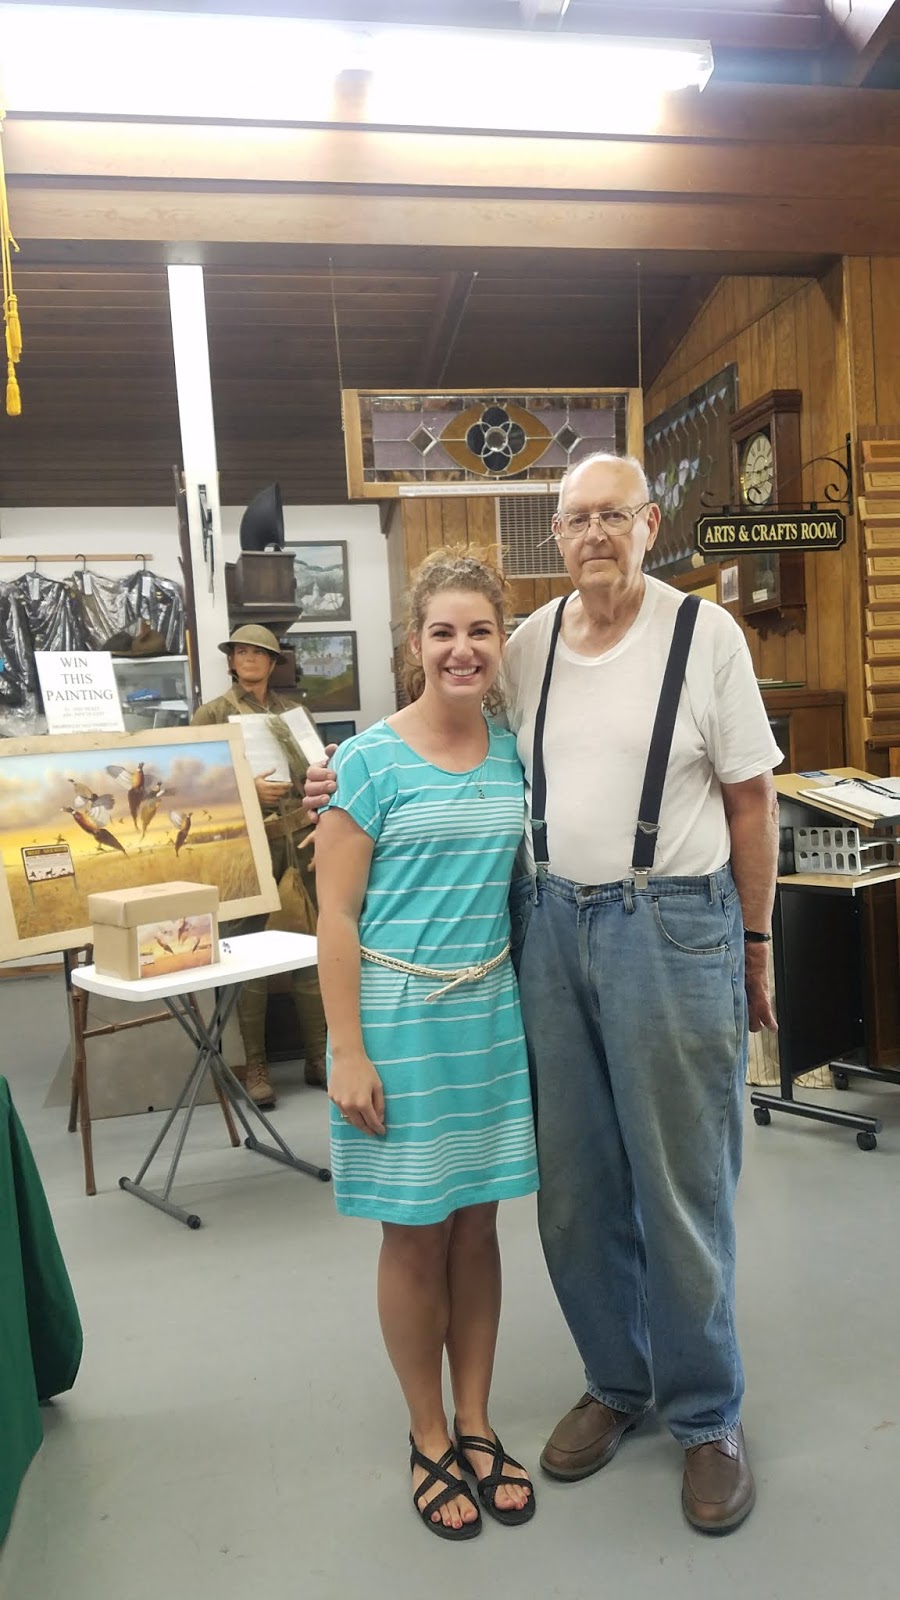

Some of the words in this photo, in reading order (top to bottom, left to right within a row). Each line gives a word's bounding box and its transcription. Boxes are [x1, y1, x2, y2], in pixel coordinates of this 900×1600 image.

[705, 525, 735, 543] ARTS
[739, 524, 750, 541] &
[751, 523, 797, 541] CRAFTS
[801, 522, 837, 539] ROOM
[60, 657, 88, 668] WIN
[60, 673, 93, 684] THIS
[46, 689, 113, 701] PAINTING
